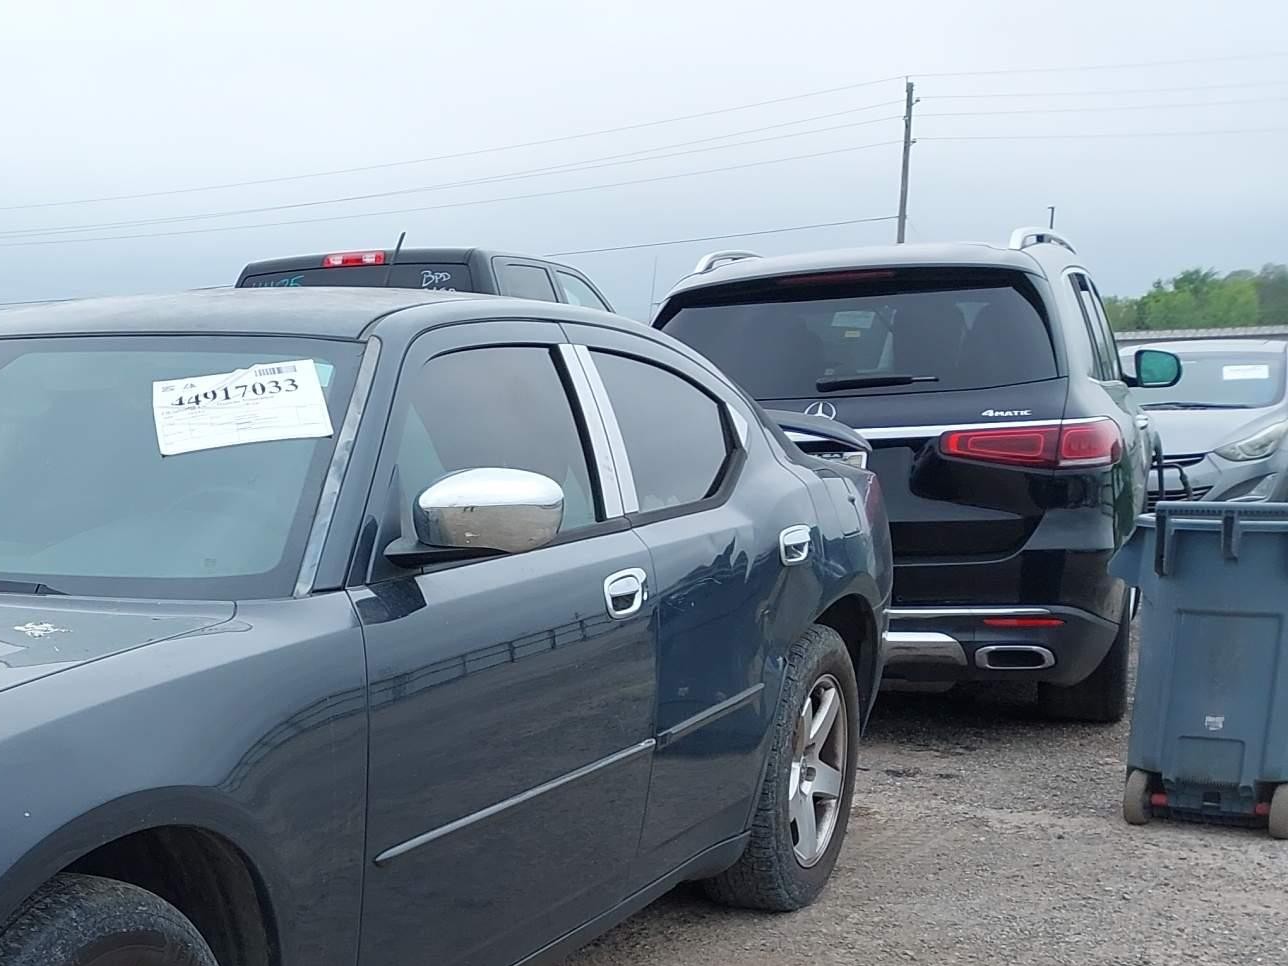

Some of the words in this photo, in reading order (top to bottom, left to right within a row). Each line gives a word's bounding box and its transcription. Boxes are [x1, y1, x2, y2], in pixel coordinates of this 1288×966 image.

[421, 270, 451, 287] BPD
[171, 377, 300, 406] 44917033
[981, 409, 1033, 417] 4MATIC
